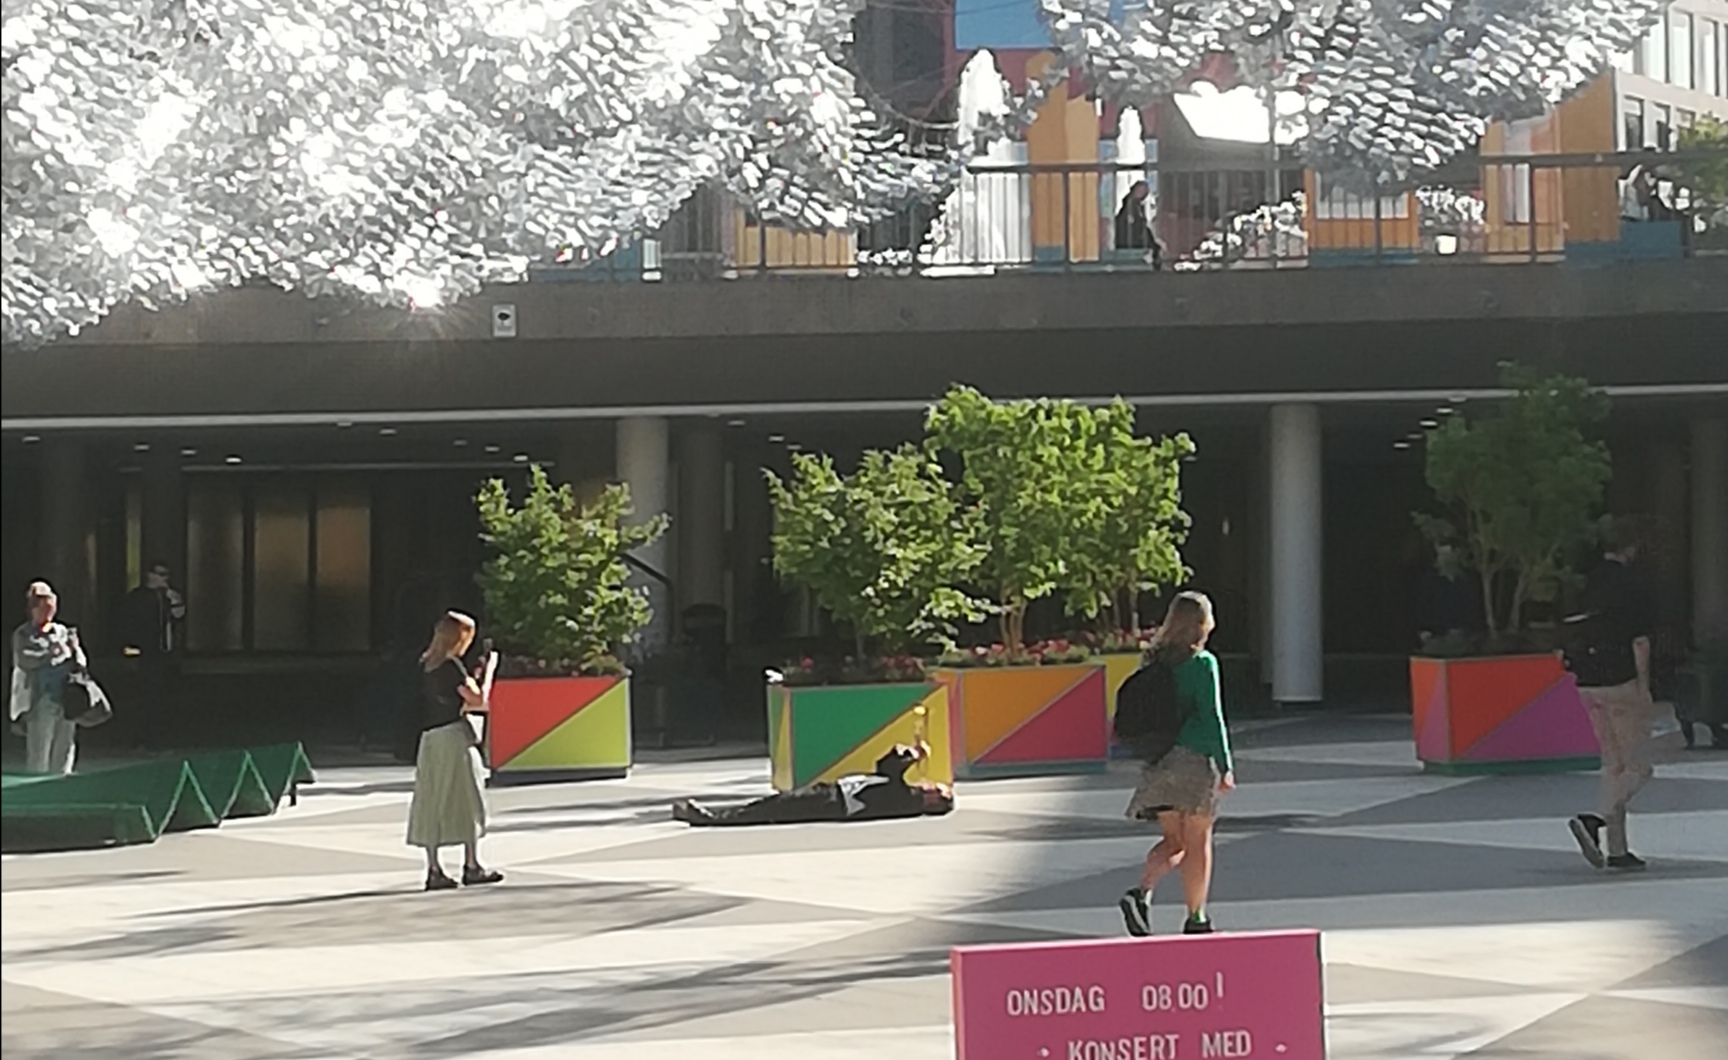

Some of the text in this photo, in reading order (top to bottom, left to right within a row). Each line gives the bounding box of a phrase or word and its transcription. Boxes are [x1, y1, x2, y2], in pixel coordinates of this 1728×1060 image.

[1007, 985, 1105, 1016] ONSDAG
[1068, 1029, 1252, 1060] KONSERT MED
